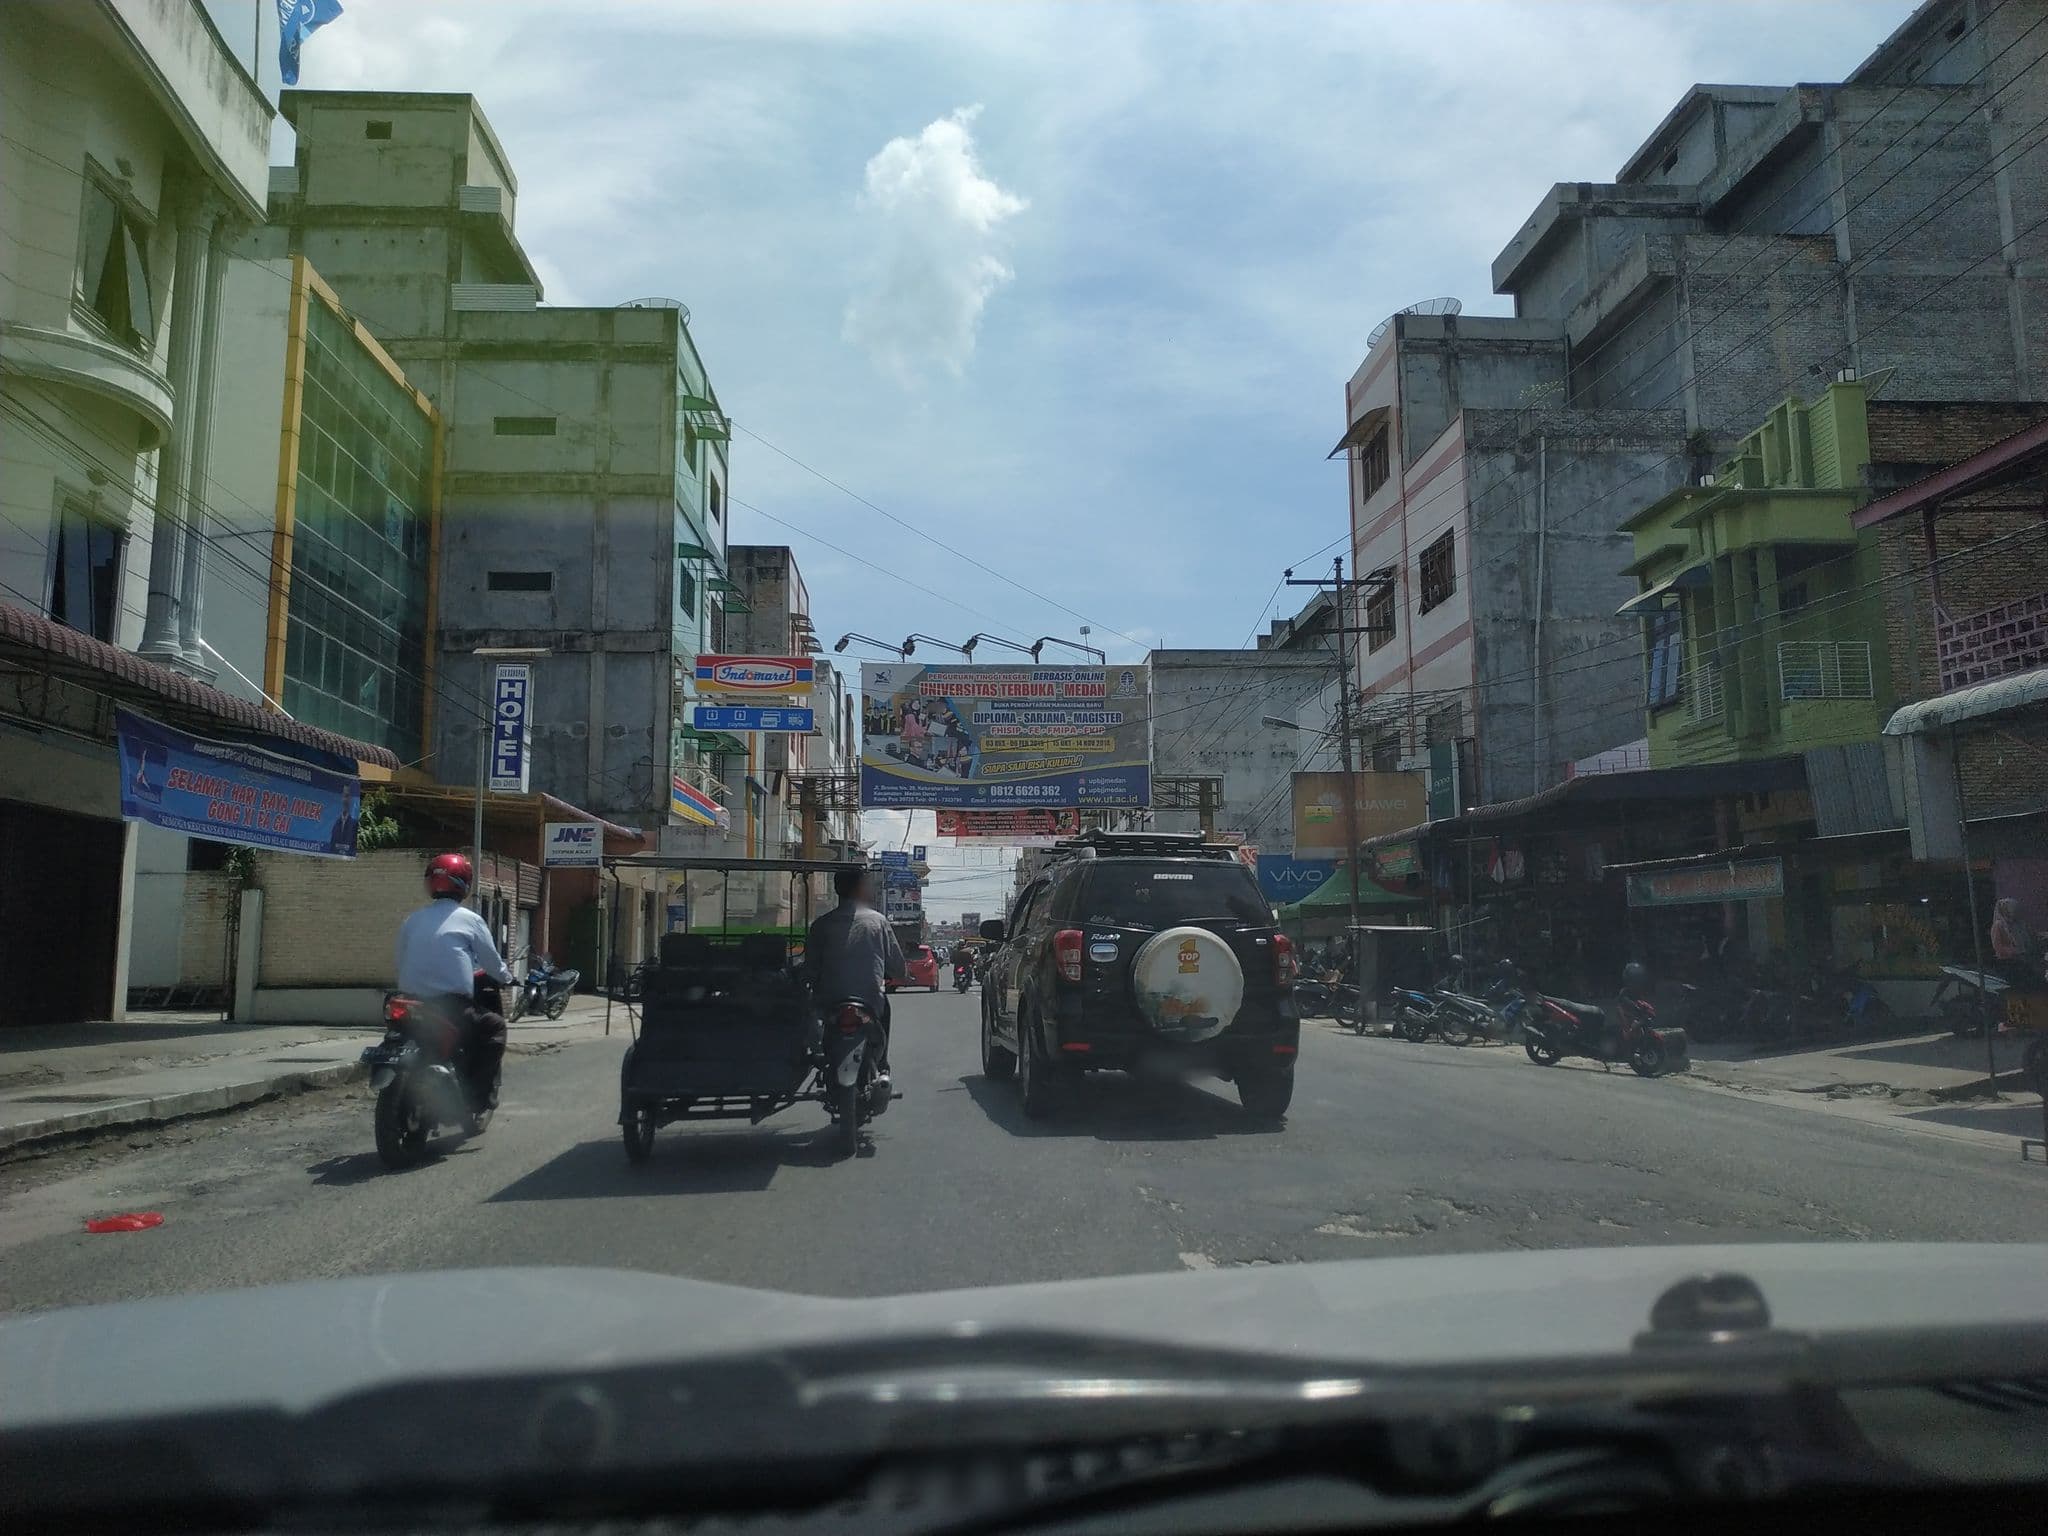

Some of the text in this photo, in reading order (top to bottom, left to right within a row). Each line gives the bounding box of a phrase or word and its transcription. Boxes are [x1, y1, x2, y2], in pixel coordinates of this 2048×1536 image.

[719, 666, 792, 681] Indomaret
[1033, 672, 1072, 681] BERBASIS
[1075, 672, 1105, 681] ONLINE
[920, 683, 998, 696] UNIVERSITAS
[1000, 683, 1054, 696] TERBUKA
[1064, 683, 1105, 696] MEDAN
[974, 713, 1016, 723] DIPLOMA
[1024, 713, 1066, 723] SARJANA
[1074, 713, 1122, 723] MAGISTER
[497, 682, 523, 776] HOTEL
[1030, 726, 1040, 734] FE
[1048, 726, 1076, 734] FMIPA
[167, 767, 229, 798] SELAMAT
[232, 783, 258, 805] HARI
[261, 790, 288, 813] RAYA
[290, 797, 323, 821] IMLEK
[990, 786, 1060, 796] 0812 6626 362
[1078, 795, 1138, 804] www.ut.ac.id
[208, 800, 240, 824] GONG
[243, 806, 255, 828] XI
[552, 828, 596, 842] JNE
[915, 848, 924, 860] P
[1270, 867, 1323, 882] vivo
[1180, 952, 1198, 961] TOP
